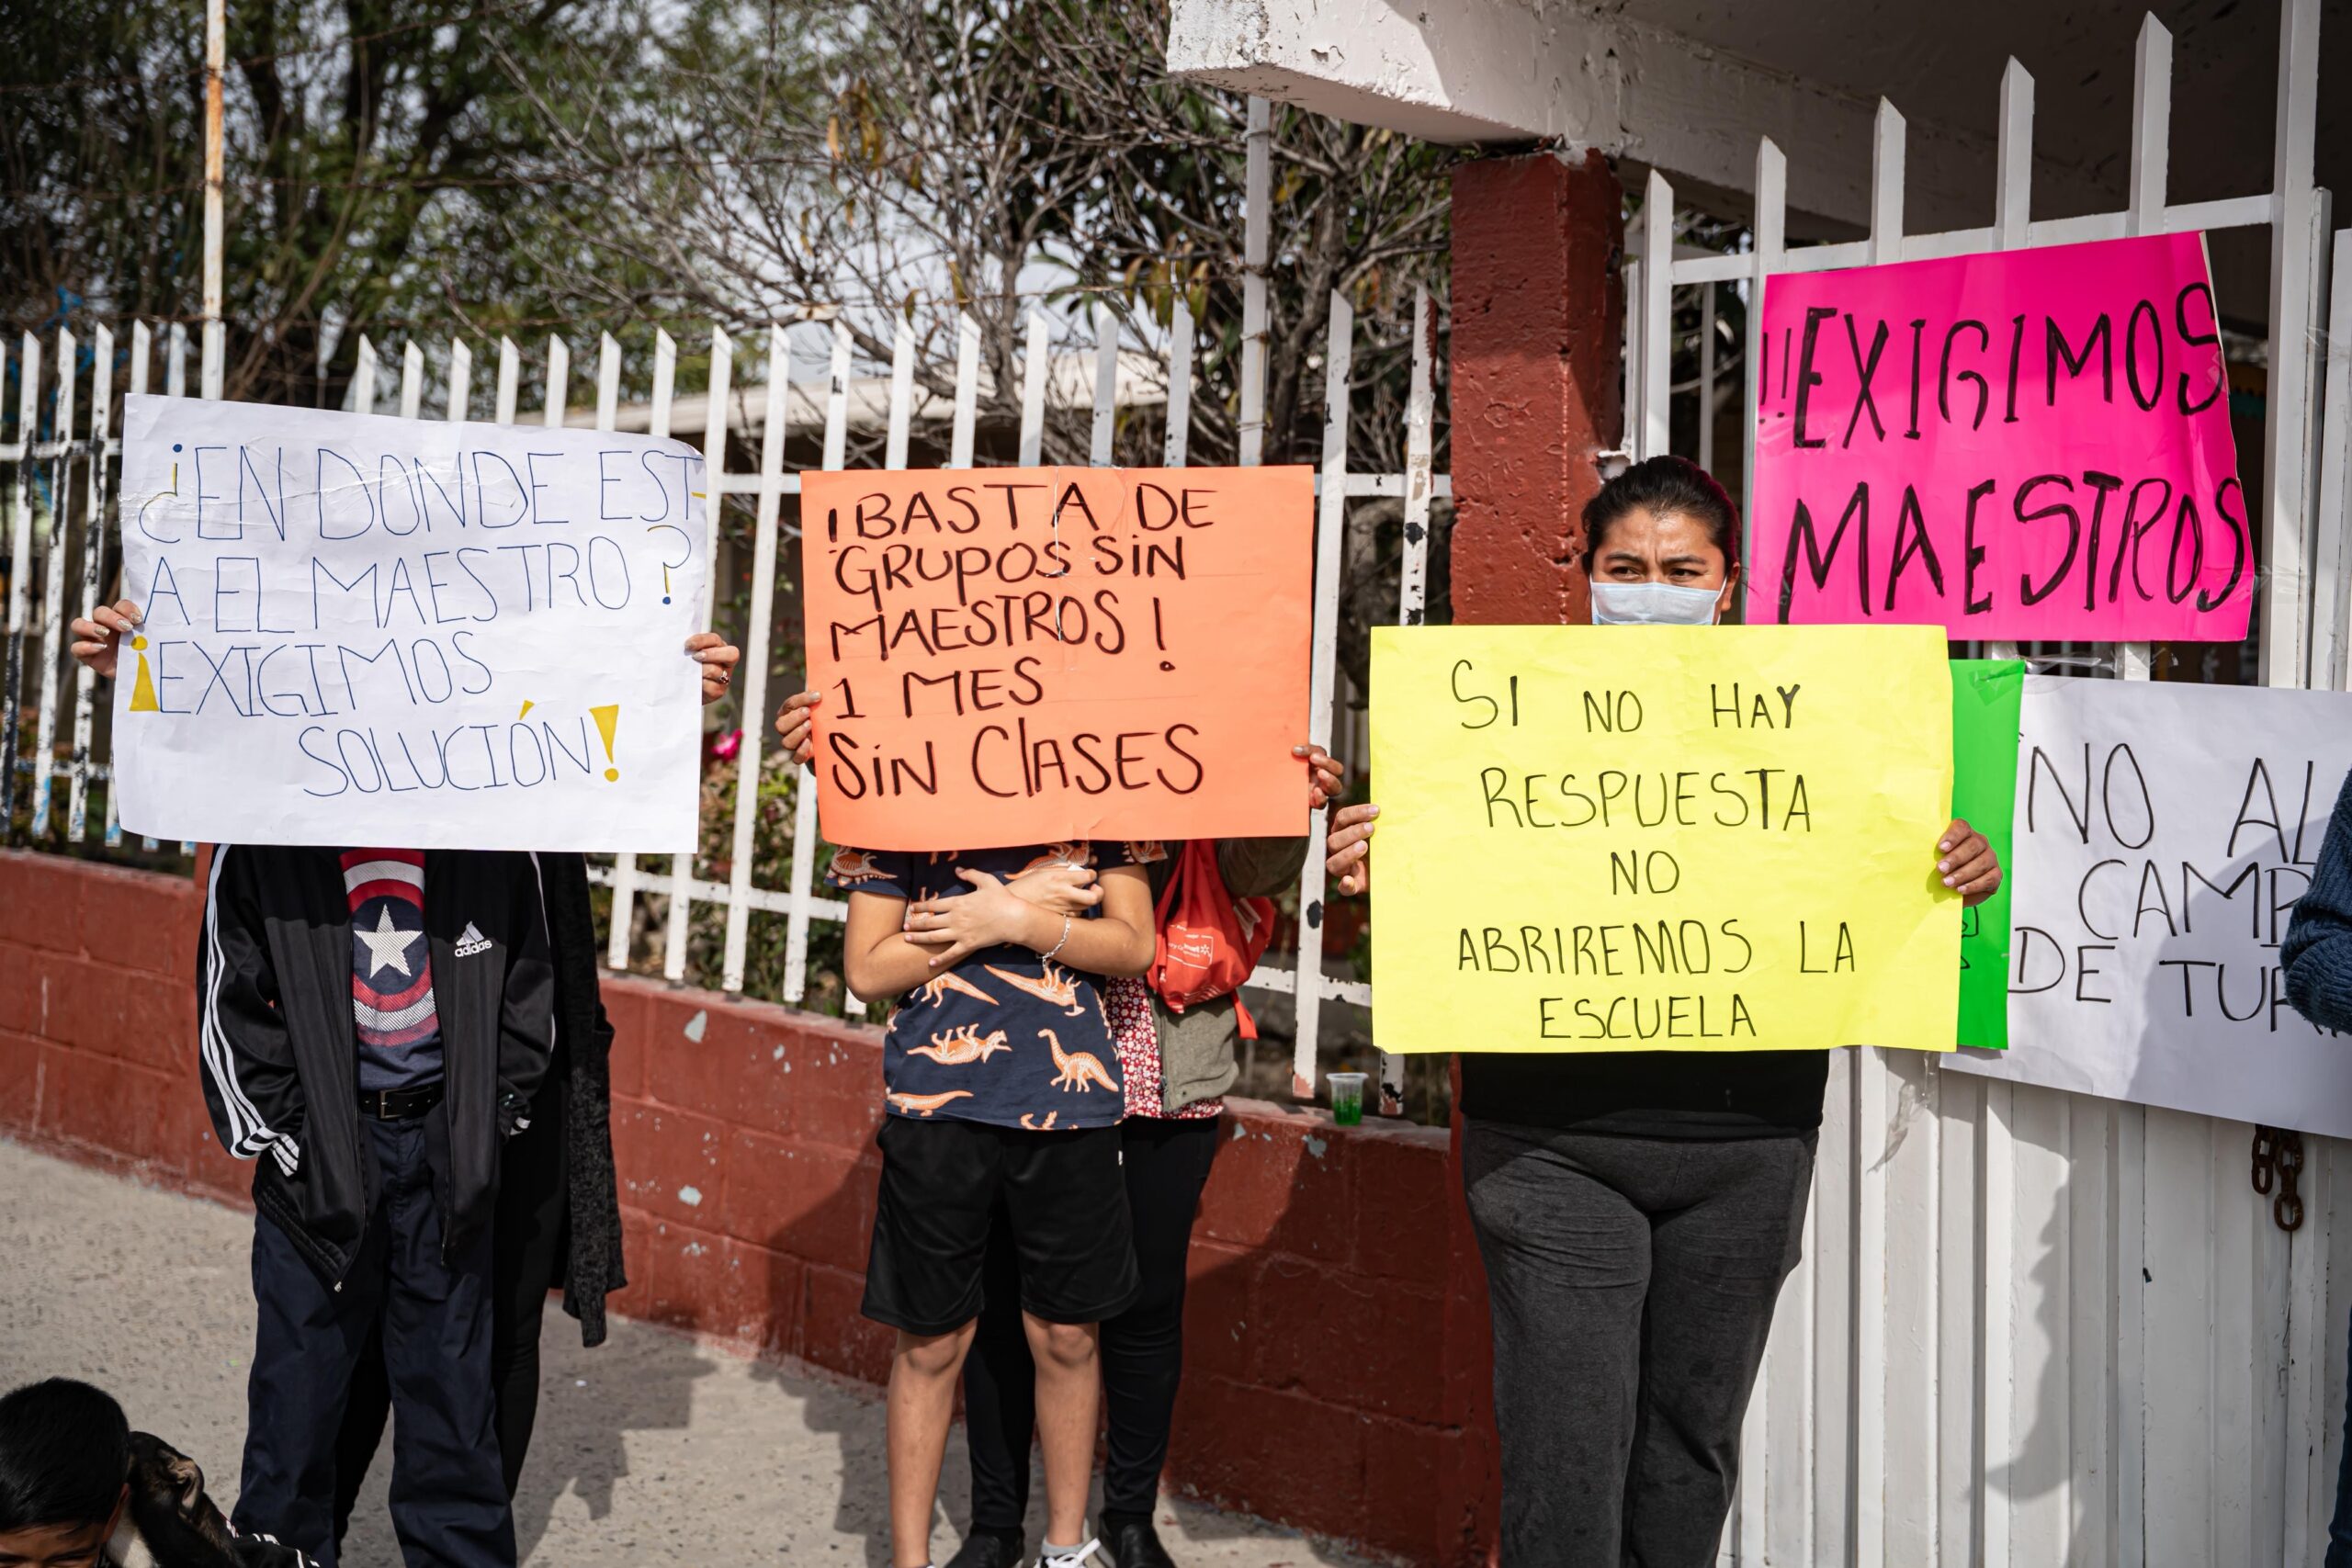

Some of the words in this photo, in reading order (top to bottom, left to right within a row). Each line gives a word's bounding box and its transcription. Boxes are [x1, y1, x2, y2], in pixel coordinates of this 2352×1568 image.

[139, 444, 286, 543] ¿EN
[317, 448, 569, 540] DONDE
[1136, 482, 1219, 531] DE
[834, 542, 1071, 612] GRUPOS
[1778, 470, 2245, 626] MAESTROS
[144, 556, 190, 626] A
[215, 557, 295, 634] EL
[832, 678, 866, 720] 1
[902, 656, 1044, 718] MES
[1451, 659, 1519, 729] SI
[1584, 690, 1644, 733] NO
[1711, 682, 1802, 728] HAY
[298, 699, 621, 797] SOLUCIÓN!
[1480, 766, 1811, 832] RESPUESTA
[2028, 742, 2154, 850] NO
[1611, 850, 1679, 896] NO
[454, 940, 492, 957] adidas
[1458, 919, 1752, 976] ABRIREMOS
[1800, 920, 1855, 974] LA
[2007, 926, 2117, 1003] DE
[1540, 993, 1757, 1039] ESCUELA
